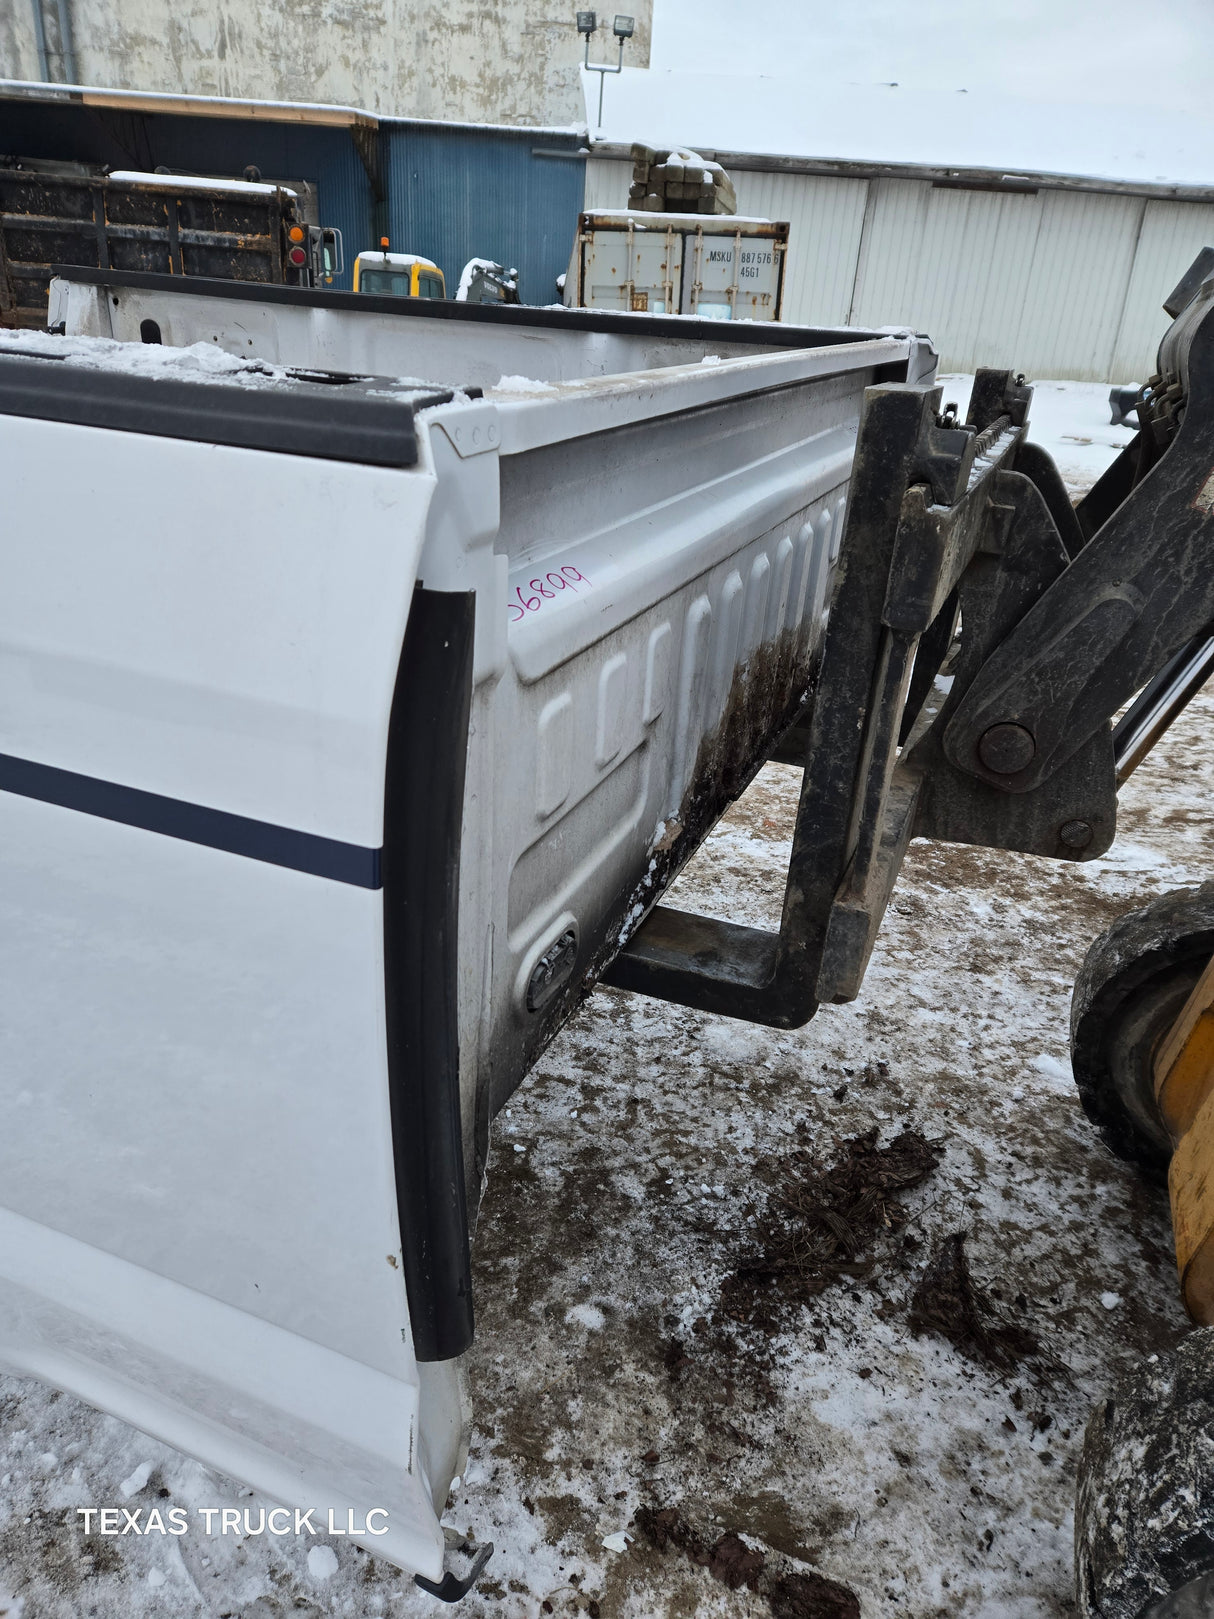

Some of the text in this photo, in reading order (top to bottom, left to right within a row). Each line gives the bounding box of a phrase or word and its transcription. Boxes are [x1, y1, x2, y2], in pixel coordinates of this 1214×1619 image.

[709, 250, 732, 262] MSKU
[773, 253, 779, 265] 6
[740, 266, 759, 278] 45G1
